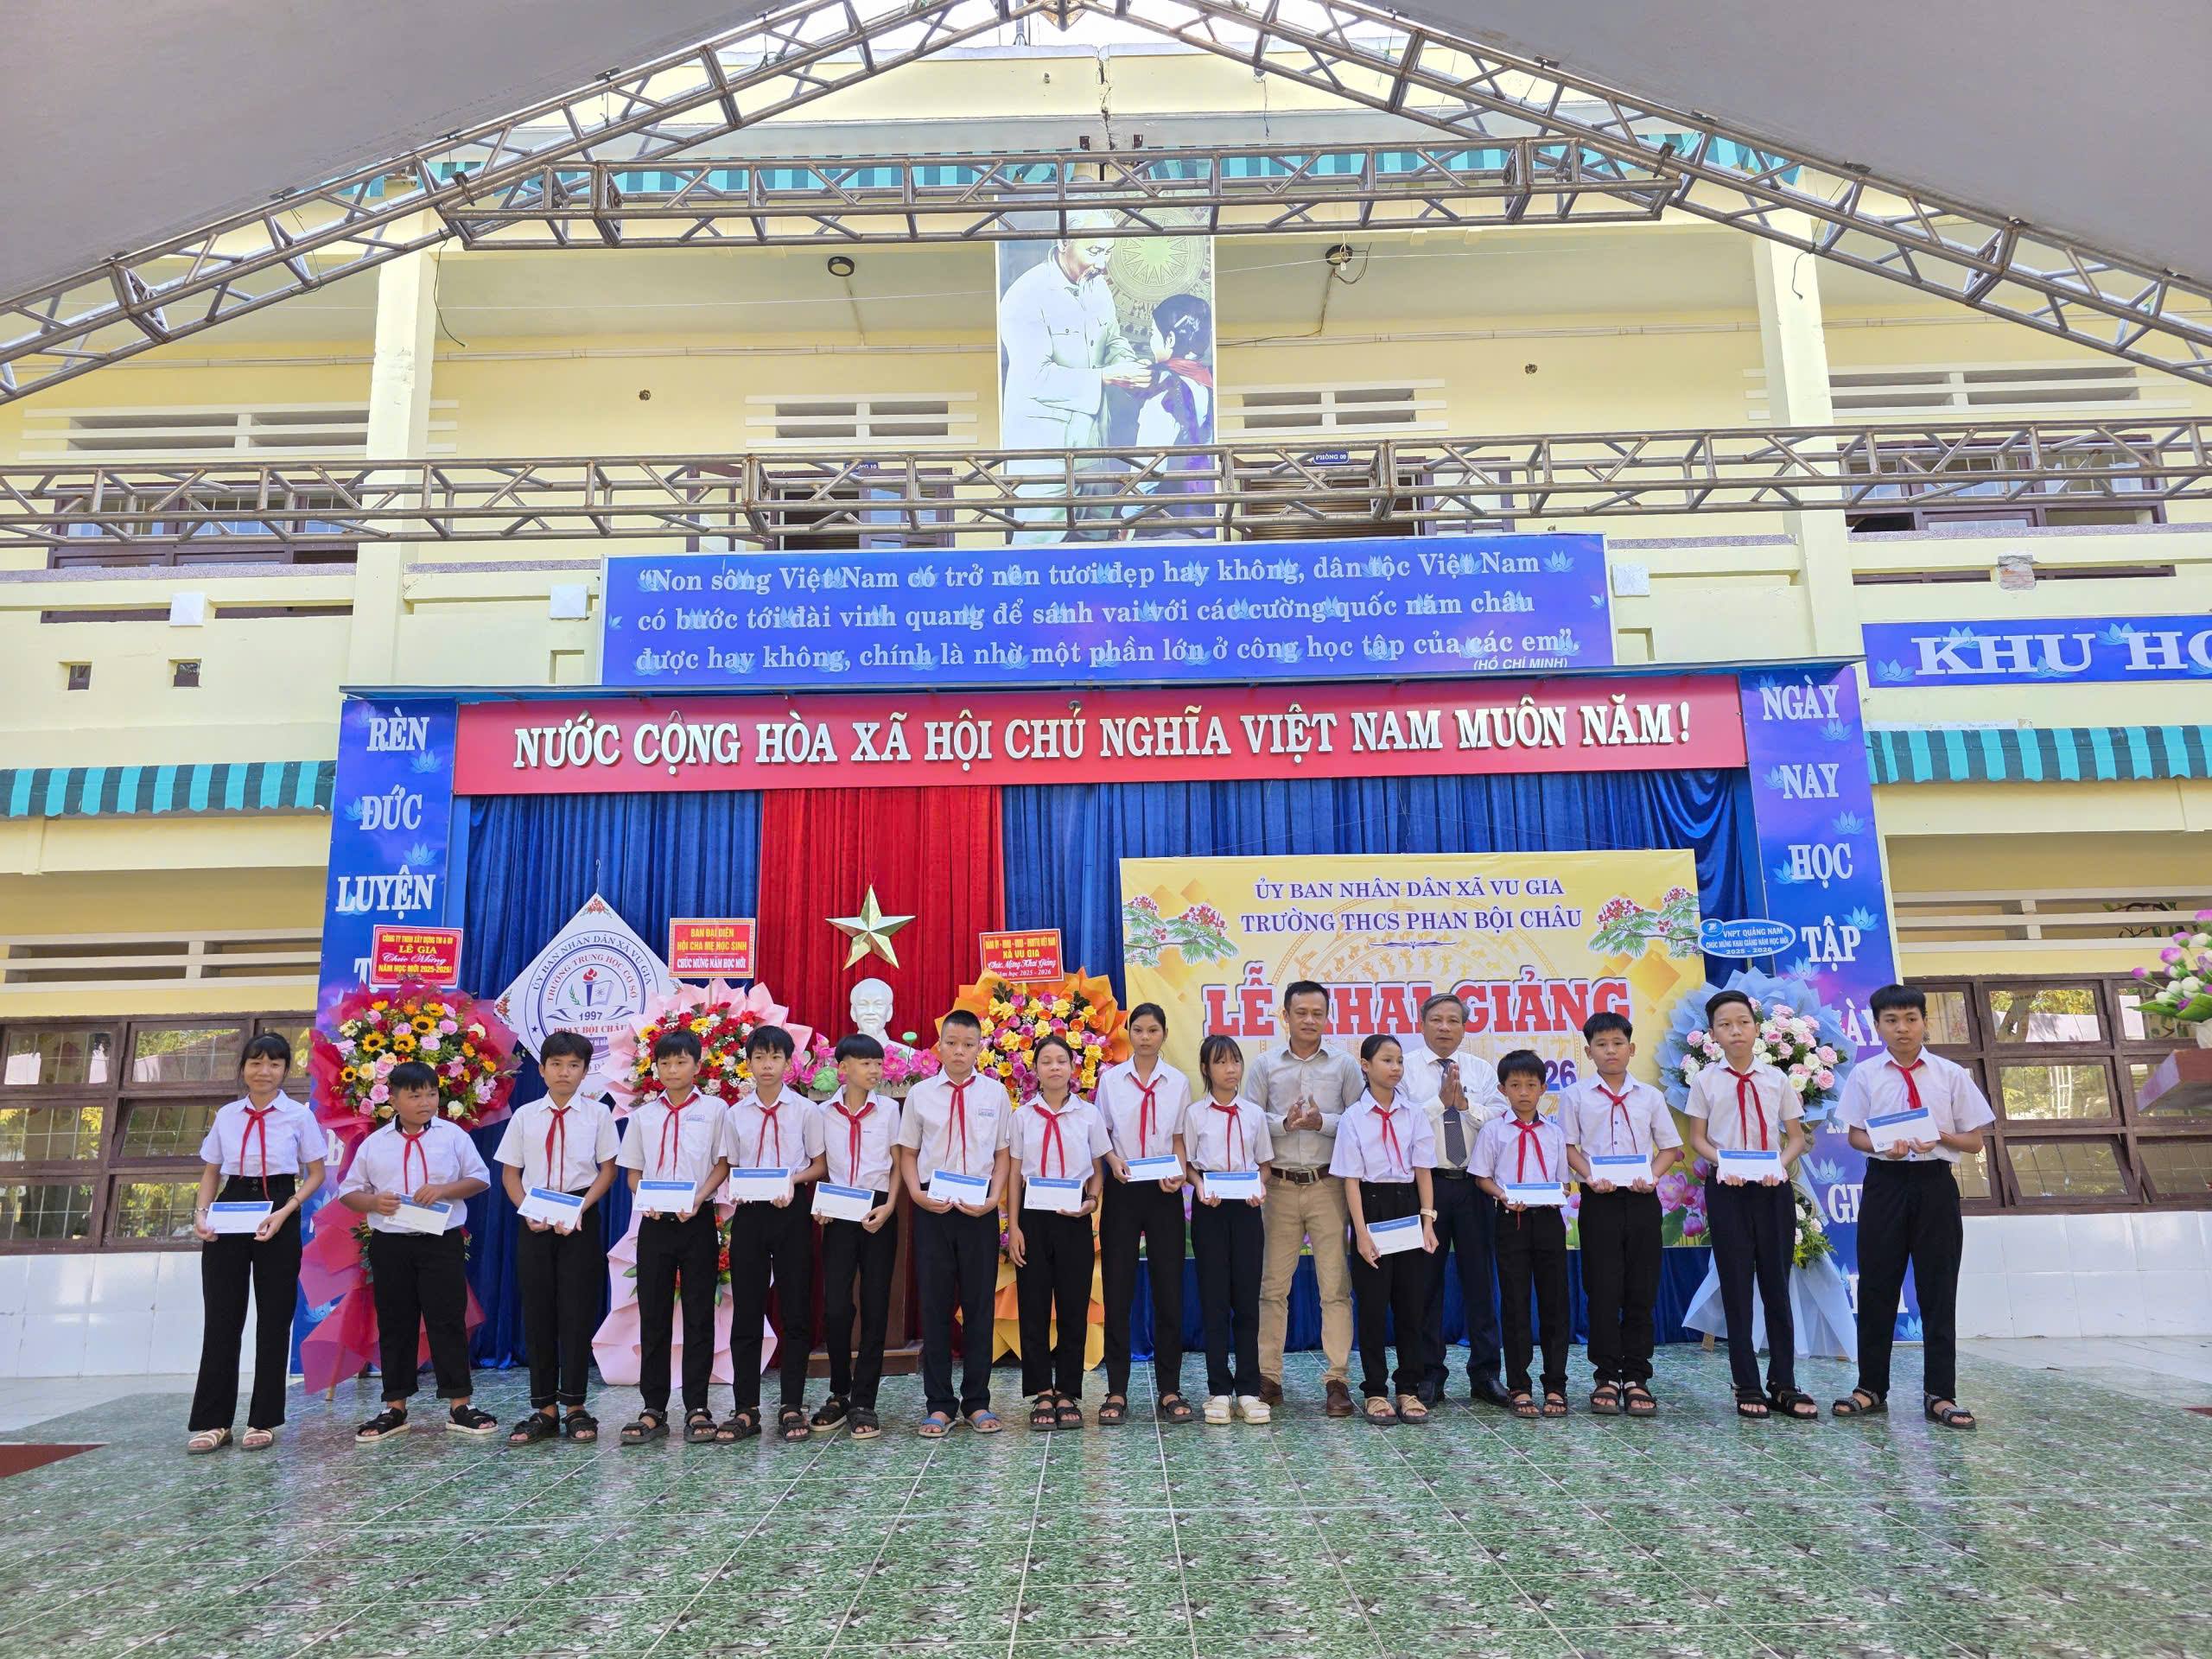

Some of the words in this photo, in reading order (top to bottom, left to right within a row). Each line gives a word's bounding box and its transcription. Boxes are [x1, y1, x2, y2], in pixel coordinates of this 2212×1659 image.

[711, 566, 772, 594] sông
[779, 566, 831, 593] Việt
[841, 566, 899, 588] Nam
[907, 564, 937, 588] có
[944, 562, 982, 588] trở
[993, 564, 1040, 587] nên
[1049, 562, 1097, 586] tươi
[1109, 561, 1154, 588] đẹp
[1163, 561, 1209, 588] hay
[1218, 558, 1305, 585] không,
[1313, 557, 1361, 580] dân
[1370, 556, 1410, 581] tộc
[1418, 553, 1471, 578] Việt
[1480, 552, 1540, 574] Nam
[638, 607, 665, 632] có
[677, 605, 738, 630] bước
[747, 605, 780, 628] tới
[790, 605, 830, 628] đài
[839, 604, 896, 626] vinh
[906, 606, 984, 632] quang
[993, 599, 1023, 625] để
[1033, 601, 1093, 623] sánh
[1102, 600, 1141, 623] vai
[1148, 598, 1188, 621] với
[1197, 597, 1236, 621] các
[1249, 594, 1325, 623] cường
[1336, 593, 1397, 622] quốc
[1406, 593, 1461, 615] năm
[1471, 590, 1535, 613] châu
[636, 646, 698, 674] được
[708, 648, 754, 674] hay
[763, 645, 851, 672] không,
[860, 643, 932, 668] chính
[941, 641, 964, 664] là
[974, 641, 1023, 664] nhờ
[1031, 639, 1081, 665] một
[1090, 636, 1154, 667] phần
[1163, 635, 1208, 661] lớn
[1212, 634, 1226, 660] ở
[1237, 637, 1297, 664] công
[1307, 634, 1354, 663] học
[1362, 634, 1404, 661] tập
[1471, 630, 1512, 653] các
[1503, 656, 1526, 670] CHÍ
[1529, 658, 1567, 669] MINH)
[1910, 633, 2095, 676] KHU
[1759, 674, 1840, 721] NGÀY
[366, 706, 429, 753] RÈN
[513, 709, 620, 769] NƯỚC
[633, 709, 741, 775] CỘNG
[755, 709, 838, 763] HÒA
[851, 712, 911, 762] XÃ
[924, 709, 993, 772] HỘI
[1004, 702, 1085, 760] CHỦ
[1100, 705, 1230, 758] NGHĨA
[1240, 704, 1338, 764] VIỆT
[1351, 709, 1443, 752] NAM
[1454, 696, 1567, 750] MUÔN
[1780, 763, 1840, 799] NAY
[359, 784, 423, 831] ĐỨC
[1788, 842, 1853, 889] HỌC
[335, 865, 435, 920] LUYỆN
[1255, 878, 1284, 899] ỦY
[1290, 882, 1333, 899] BAN
[1339, 878, 1401, 898] NHÂN
[1407, 877, 1451, 897] DÂN
[1456, 877, 1486, 896] XÃ
[1490, 880, 1520, 895] VU
[1525, 879, 1564, 895] GIA
[690, 928, 705, 938] BAN
[1241, 907, 1335, 932] TRƯỜNG
[1341, 912, 1400, 931] THCS
[1406, 911, 1467, 930] PHAN
[1474, 906, 1514, 933] BỘI
[1520, 905, 1581, 928] CHÂU
[1723, 930, 1740, 938] VNPT
[417, 945, 437, 954] GIA
[542, 952, 560, 974] BAN
[561, 936, 591, 955] NHÂN
[594, 935, 616, 944] DÂN
[616, 939, 629, 952] XÃ
[631, 950, 644, 965] VU
[641, 964, 653, 985] GIA
[690, 942, 703, 950] CHA
[731, 942, 747, 950] SINH
[1802, 915, 1861, 972] TẬP
[547, 964, 571, 1002] TRƯỜNG
[571, 953, 604, 964] TRUNG
[606, 956, 624, 971] HỌC
[623, 969, 634, 981] CƠ
[579, 1011, 602, 1021] 1997
[1206, 965, 1274, 1036] LỄ
[582, 1024, 598, 1036] BỘI
